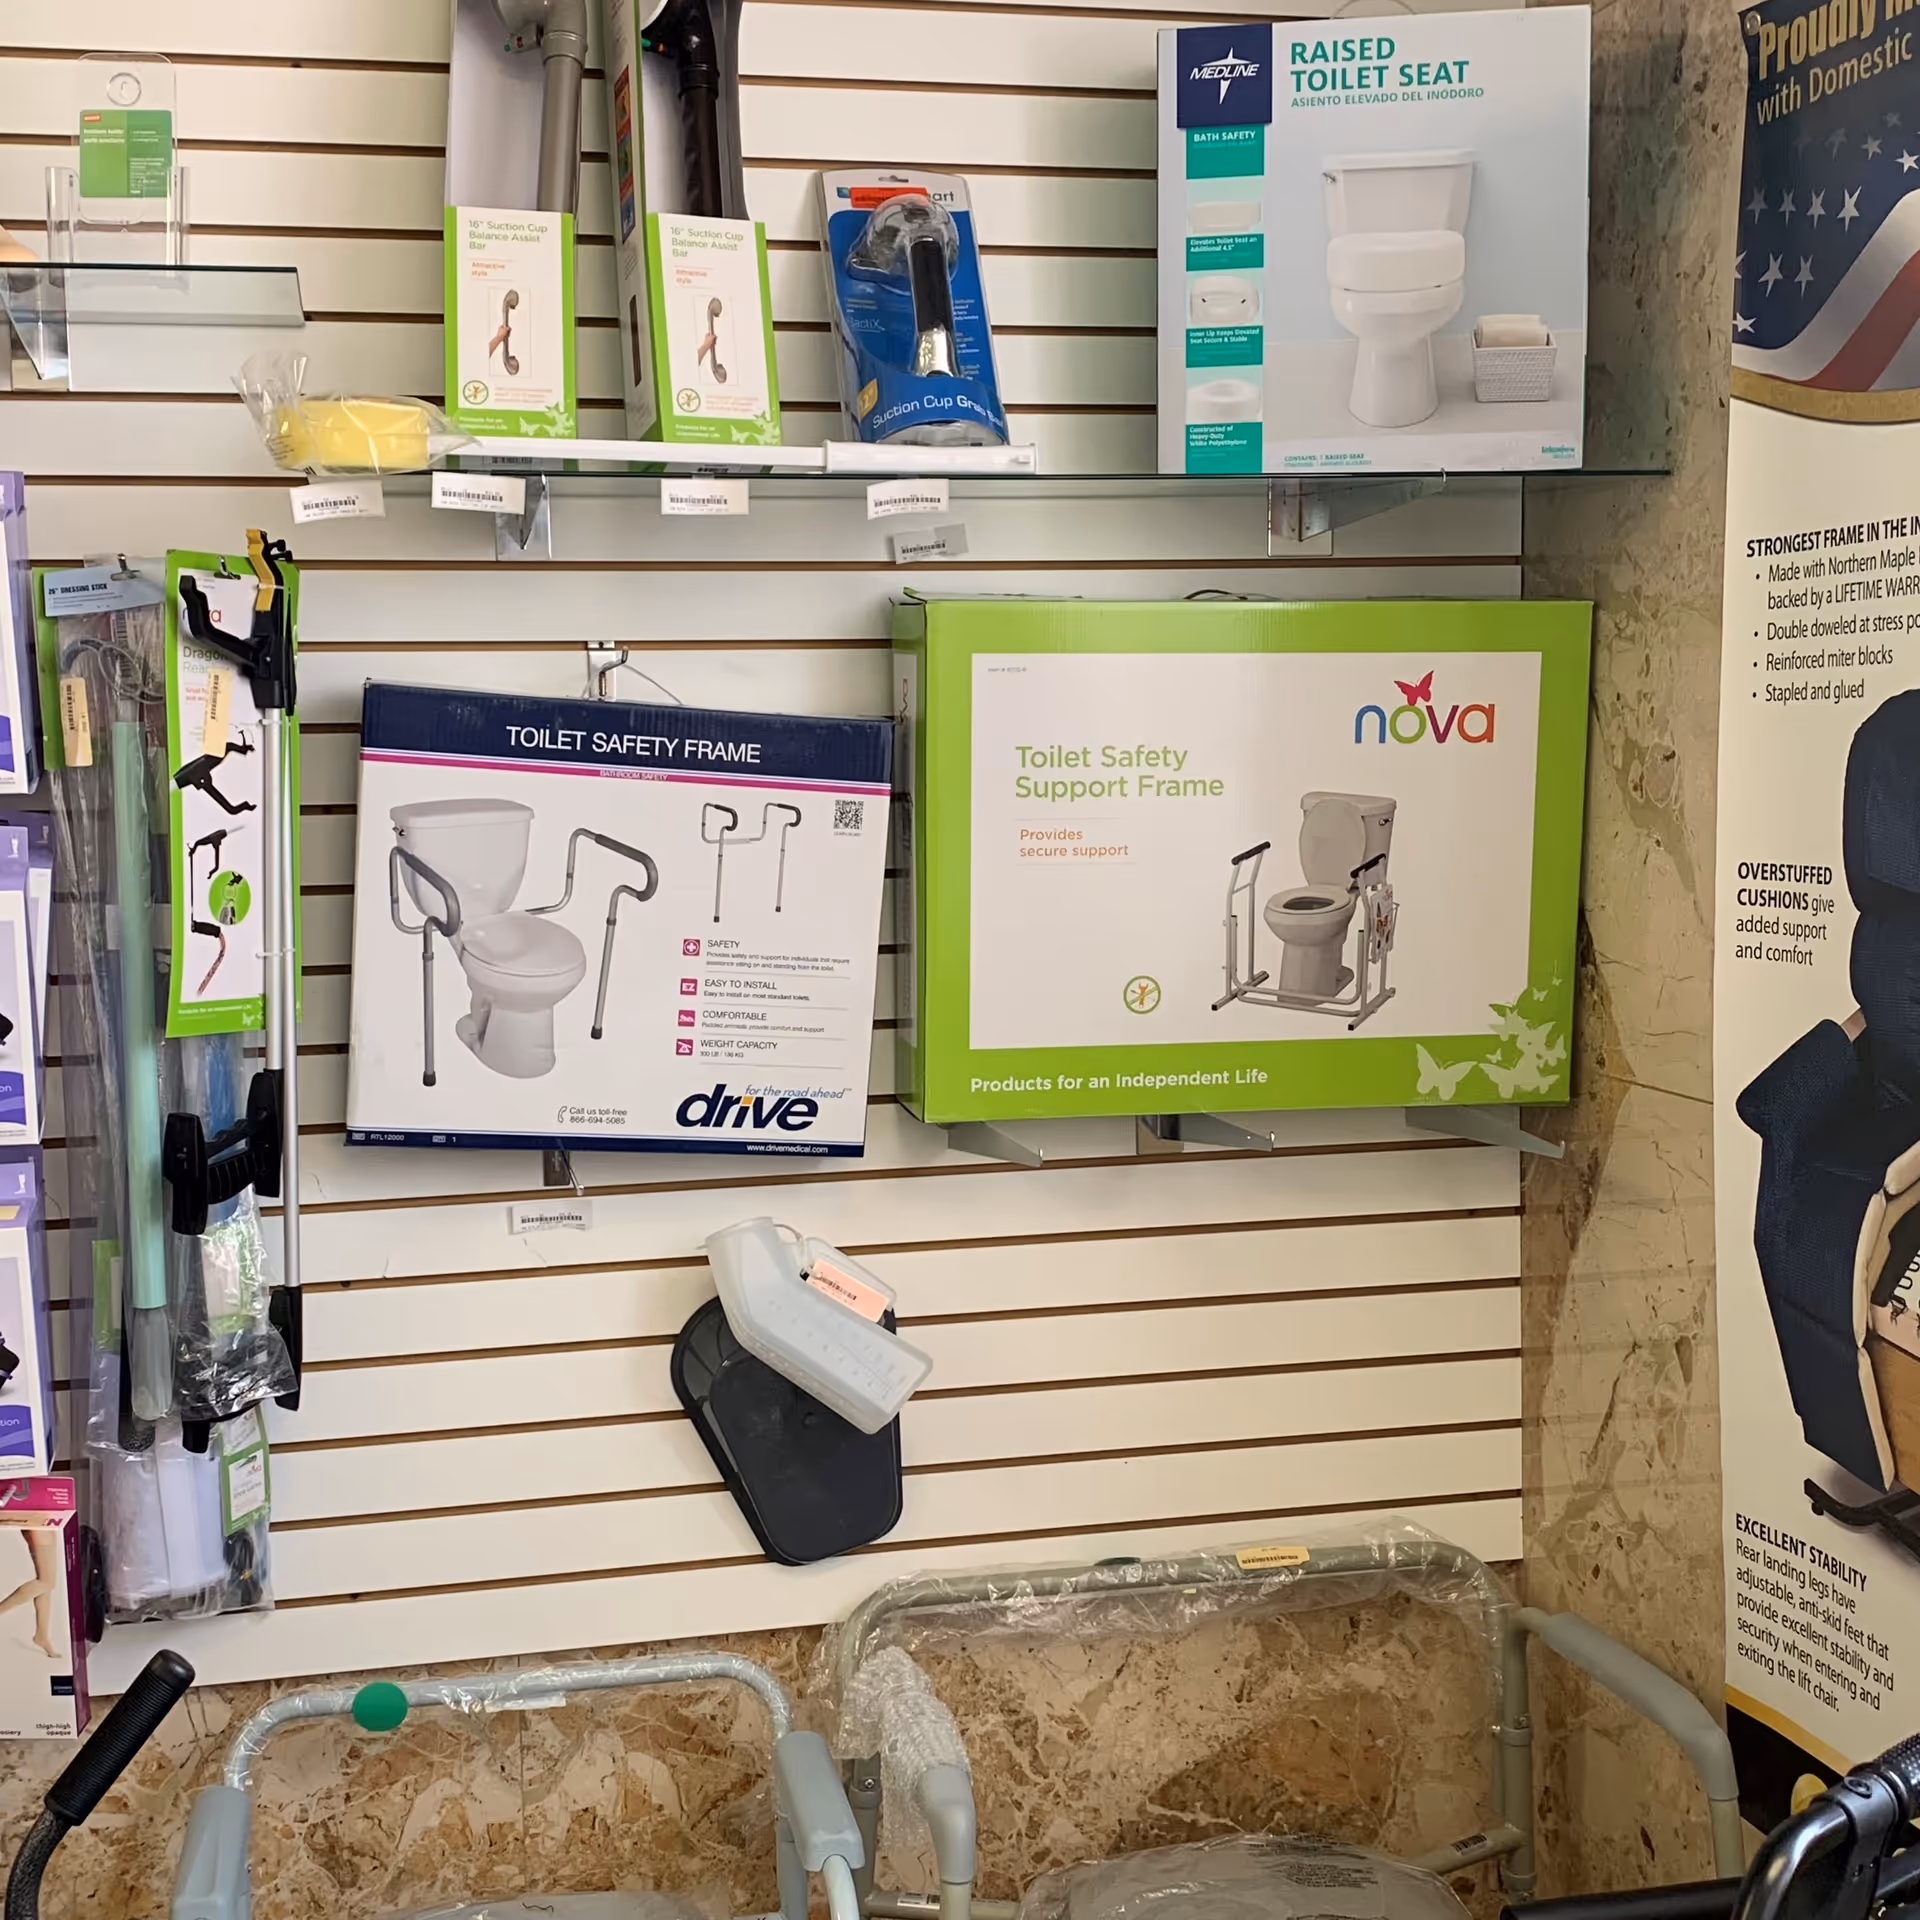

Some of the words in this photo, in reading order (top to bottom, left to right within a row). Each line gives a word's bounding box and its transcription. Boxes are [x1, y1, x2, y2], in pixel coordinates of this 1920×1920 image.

[1290, 37, 1395, 65] RAISED
[1759, 0, 1876, 81] Proudly
[1190, 63, 1260, 80] MEDLINE
[1290, 65, 1389, 92] TOILET
[1399, 60, 1469, 87] SEAT
[1757, 76, 1800, 125] with
[1809, 27, 1912, 103] Domestic
[1291, 95, 1341, 108] ASIENTO
[1345, 91, 1398, 105] ELEVADO
[1402, 90, 1423, 102] DEL
[1426, 87, 1484, 100] INODORO
[1193, 132, 1219, 142] BATH
[1222, 130, 1256, 141] SAFETY
[469, 231, 508, 241] Balance
[511, 233, 541, 243] Assist
[487, 221, 525, 232] Suction
[527, 223, 548, 233] Cup
[688, 228, 723, 239] Suction
[724, 231, 744, 242] Cup
[469, 241, 486, 250] Bar
[671, 238, 708, 248] Balance
[711, 241, 738, 251] Assist
[672, 248, 688, 257] Bar
[872, 400, 920, 429] Suction
[923, 395, 953, 409] Cup
[1746, 531, 1821, 558] STRONGEST
[1824, 524, 1864, 549] FRAME
[1867, 522, 1880, 542] IN
[1882, 517, 1907, 540] THE
[1768, 562, 1801, 583] Made
[1803, 558, 1826, 579] with
[1828, 553, 1877, 575] Northern
[1880, 546, 1916, 572] Maple
[1768, 587, 1808, 610] backed
[1810, 586, 1824, 610] by
[1826, 590, 1833, 604] a
[1835, 579, 1882, 603] LIFETIME
[1767, 619, 1808, 640] Double
[1810, 614, 1857, 638] doweled
[1859, 616, 1870, 633] at
[1873, 614, 1903, 632] stress
[1766, 649, 1825, 671] Reinforced
[1828, 645, 1856, 667] miter
[1858, 644, 1893, 665] blocks
[1765, 681, 1808, 706] Stapled
[1810, 680, 1831, 700] and
[1834, 678, 1865, 704] glued
[1355, 704, 1495, 744] nova
[505, 725, 587, 751] TOILET
[592, 731, 679, 757] SAFETY
[684, 738, 762, 764] FRAME
[1015, 745, 1091, 769] Toilet
[1101, 744, 1188, 772] Safety
[600, 769, 640, 780] BATHROOM
[641, 771, 668, 782] SAFETY
[1015, 775, 1129, 802] Support
[1138, 774, 1224, 797] Frame
[1020, 828, 1083, 841] Provides
[1020, 846, 1067, 857] secure
[1072, 844, 1129, 859] support
[1737, 862, 1833, 886] OVERSTUFFED
[1736, 888, 1809, 911] CUSHIONS
[1811, 894, 1835, 916] give
[1736, 914, 1780, 935] added
[1782, 921, 1827, 943] support
[707, 939, 740, 949] SAFETY
[1735, 941, 1763, 960] and
[1766, 945, 1813, 966] comfort
[682, 982, 695, 992] EZ
[704, 979, 727, 988] EASY
[729, 980, 742, 988] TO
[743, 981, 777, 990] INSTALL
[702, 1010, 767, 1021] COMFORTABLE
[700, 1039, 735, 1048] WEIGHT
[736, 1040, 778, 1050] CAPACITY
[745, 1084, 760, 1098] for
[763, 1085, 782, 1097] the
[783, 1087, 808, 1098] road
[970, 1076, 1052, 1092] Products
[1057, 1074, 1083, 1090] for
[1088, 1077, 1110, 1089] an
[1116, 1070, 1230, 1089] Independent
[1235, 1068, 1268, 1084] Life
[569, 1106, 585, 1116] Call
[587, 1108, 597, 1116] us
[598, 1107, 627, 1117] toll-free
[676, 1084, 819, 1131] drive
[747, 1143, 829, 1154] www.drivemedical.com
[1735, 1513, 1807, 1559] EXCELLENT
[1809, 1546, 1867, 1592] STABILITY
[1736, 1538, 1761, 1564] Rear
[1763, 1549, 1806, 1589] landing
[1808, 1570, 1829, 1600] legs
[1832, 1583, 1856, 1614] have
[1736, 1566, 1796, 1609] adjustable,
[1799, 1595, 1841, 1633] anti-skid
[1844, 1619, 1865, 1648] feet
[1867, 1633, 1889, 1662] that
[1737, 1591, 1779, 1624] provide
[1781, 1614, 1828, 1652] excellent
[1830, 1640, 1871, 1680] stability
[1873, 1667, 1894, 1692] and
[1737, 1616, 1780, 1653] security
[1782, 1639, 1813, 1668] when
[1815, 1660, 1857, 1700] entering
[1859, 1684, 1880, 1711] and
[1737, 1641, 1774, 1677] exiting
[1777, 1660, 1796, 1684] the
[1798, 1668, 1811, 1694] lift
[1813, 1681, 1840, 1713] chair.
